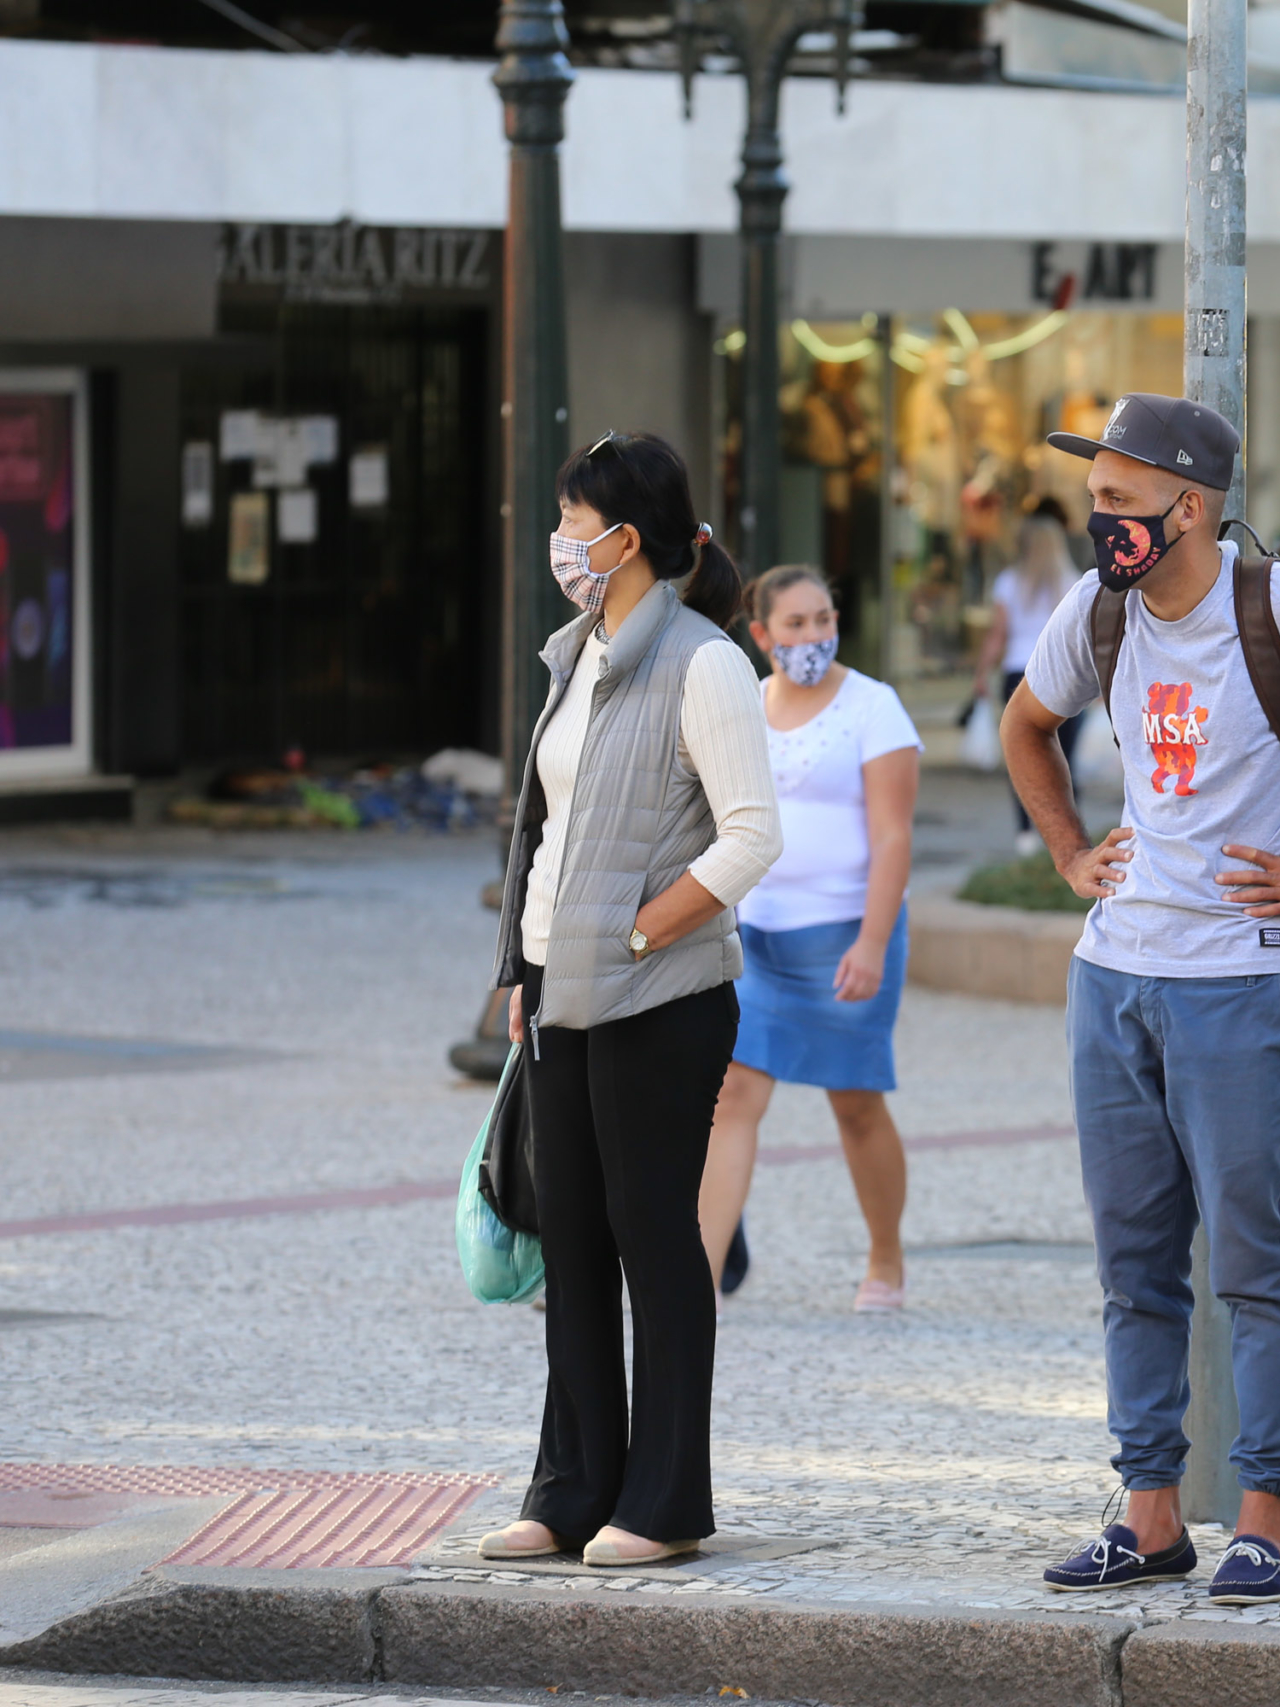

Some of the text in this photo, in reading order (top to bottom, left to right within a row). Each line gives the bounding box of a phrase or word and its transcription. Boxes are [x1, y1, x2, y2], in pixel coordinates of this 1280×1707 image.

[394, 229, 490, 289] RITZ
[1110, 563, 1121, 576] EL
[1142, 712, 1206, 745] MSA
